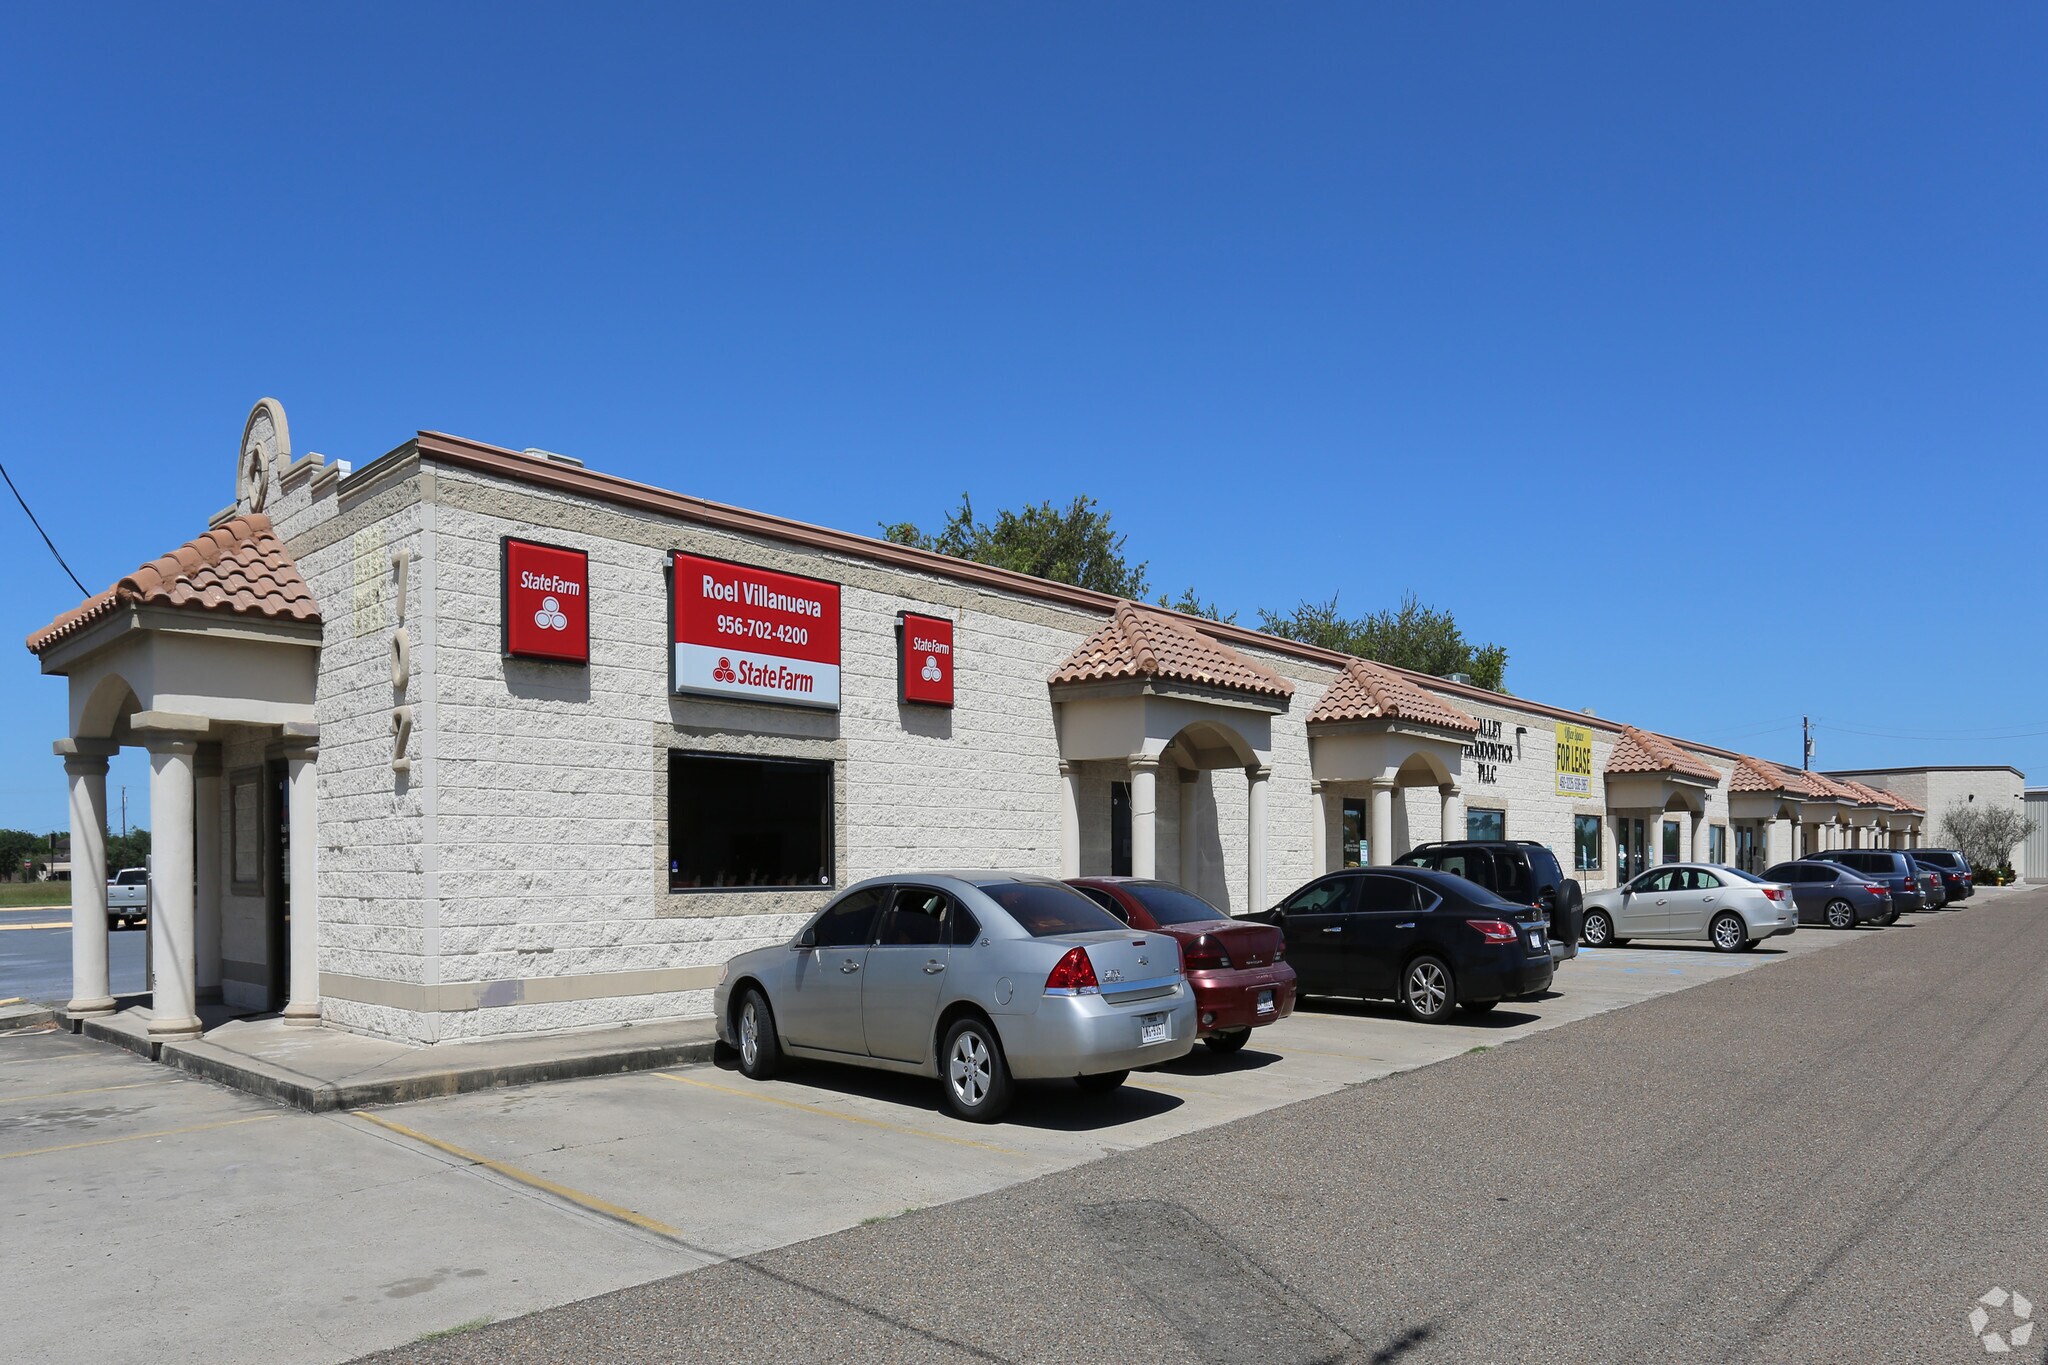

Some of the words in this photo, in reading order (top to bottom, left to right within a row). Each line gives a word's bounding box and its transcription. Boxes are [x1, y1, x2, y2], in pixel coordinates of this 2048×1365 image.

[702, 574, 739, 603] Roel
[743, 581, 822, 618] Villanueva
[717, 614, 809, 646] 956-702-4200
[1473, 717, 1503, 740] ALLEY
[1478, 762, 1497, 783] PLLC
[1557, 743, 1570, 772] FOR
[1571, 746, 1591, 775] LEASE
